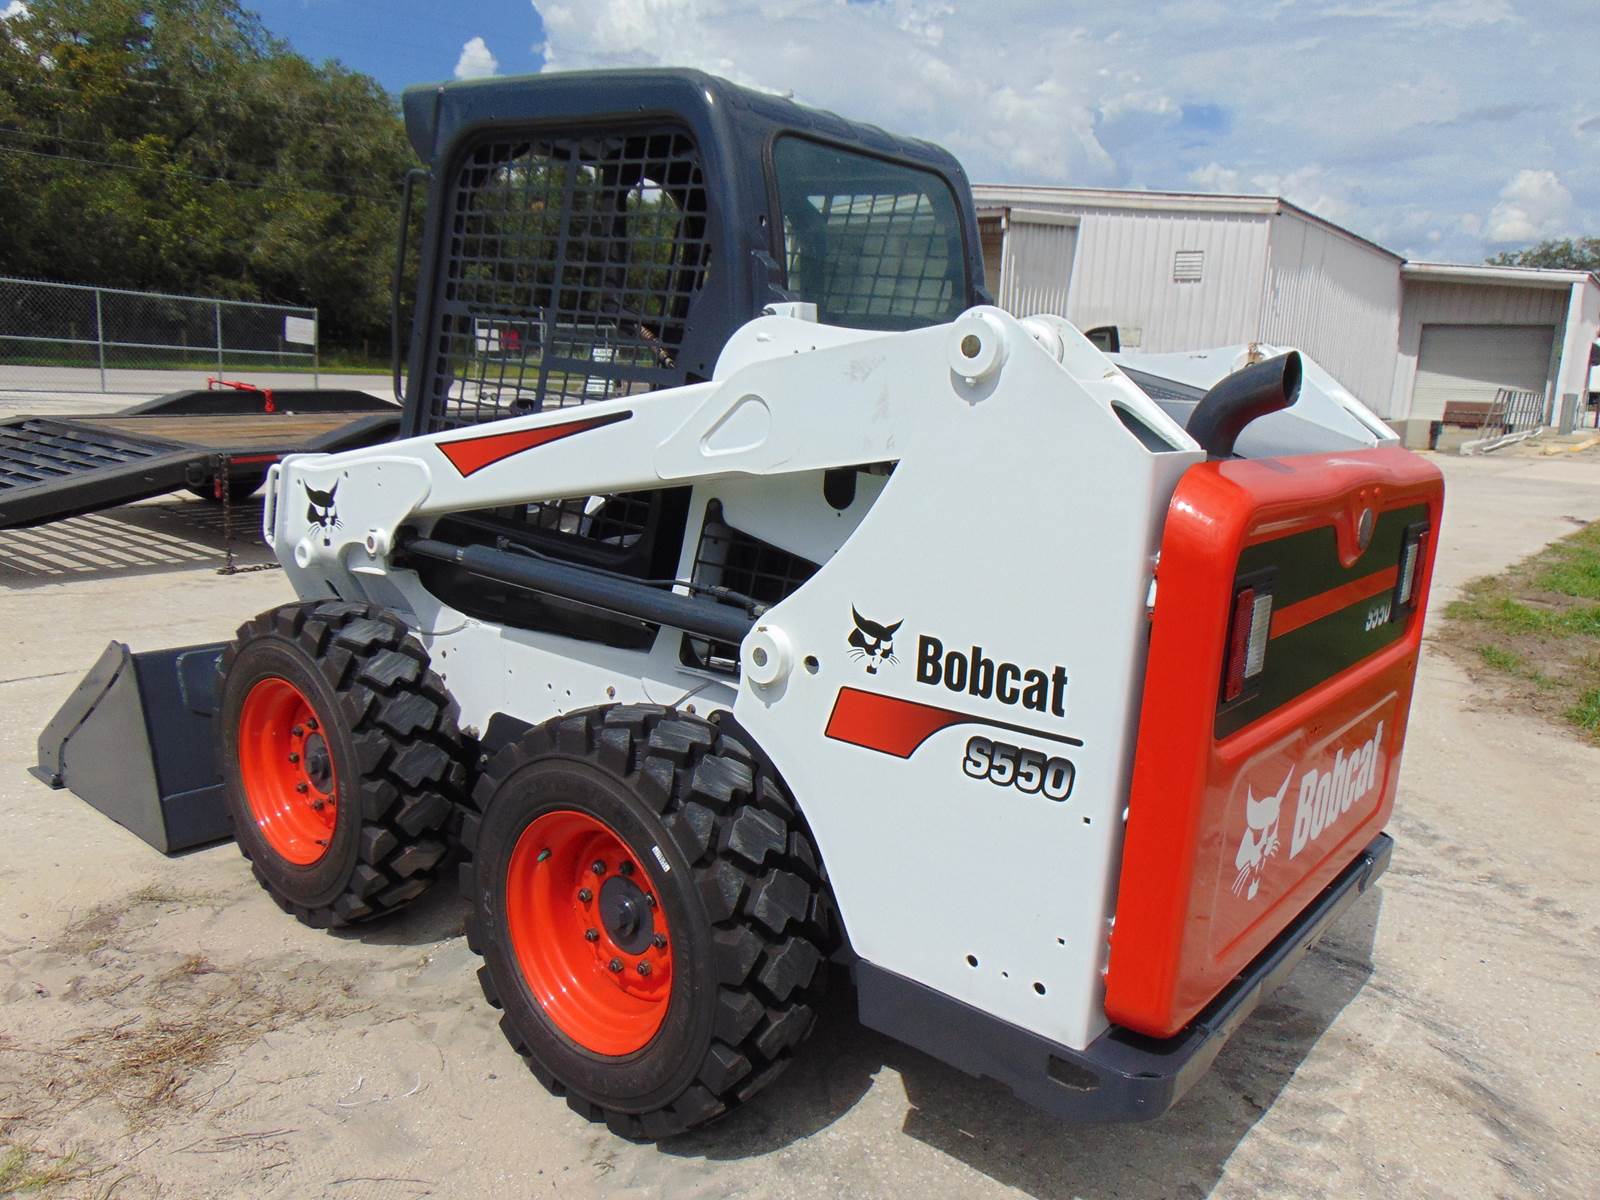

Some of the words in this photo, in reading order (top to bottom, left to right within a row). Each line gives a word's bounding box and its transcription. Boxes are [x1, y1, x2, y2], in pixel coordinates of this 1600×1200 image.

[917, 635, 1067, 717] Bobcat
[963, 736, 1075, 802] S550
[1290, 720, 1384, 860] Bobcat
